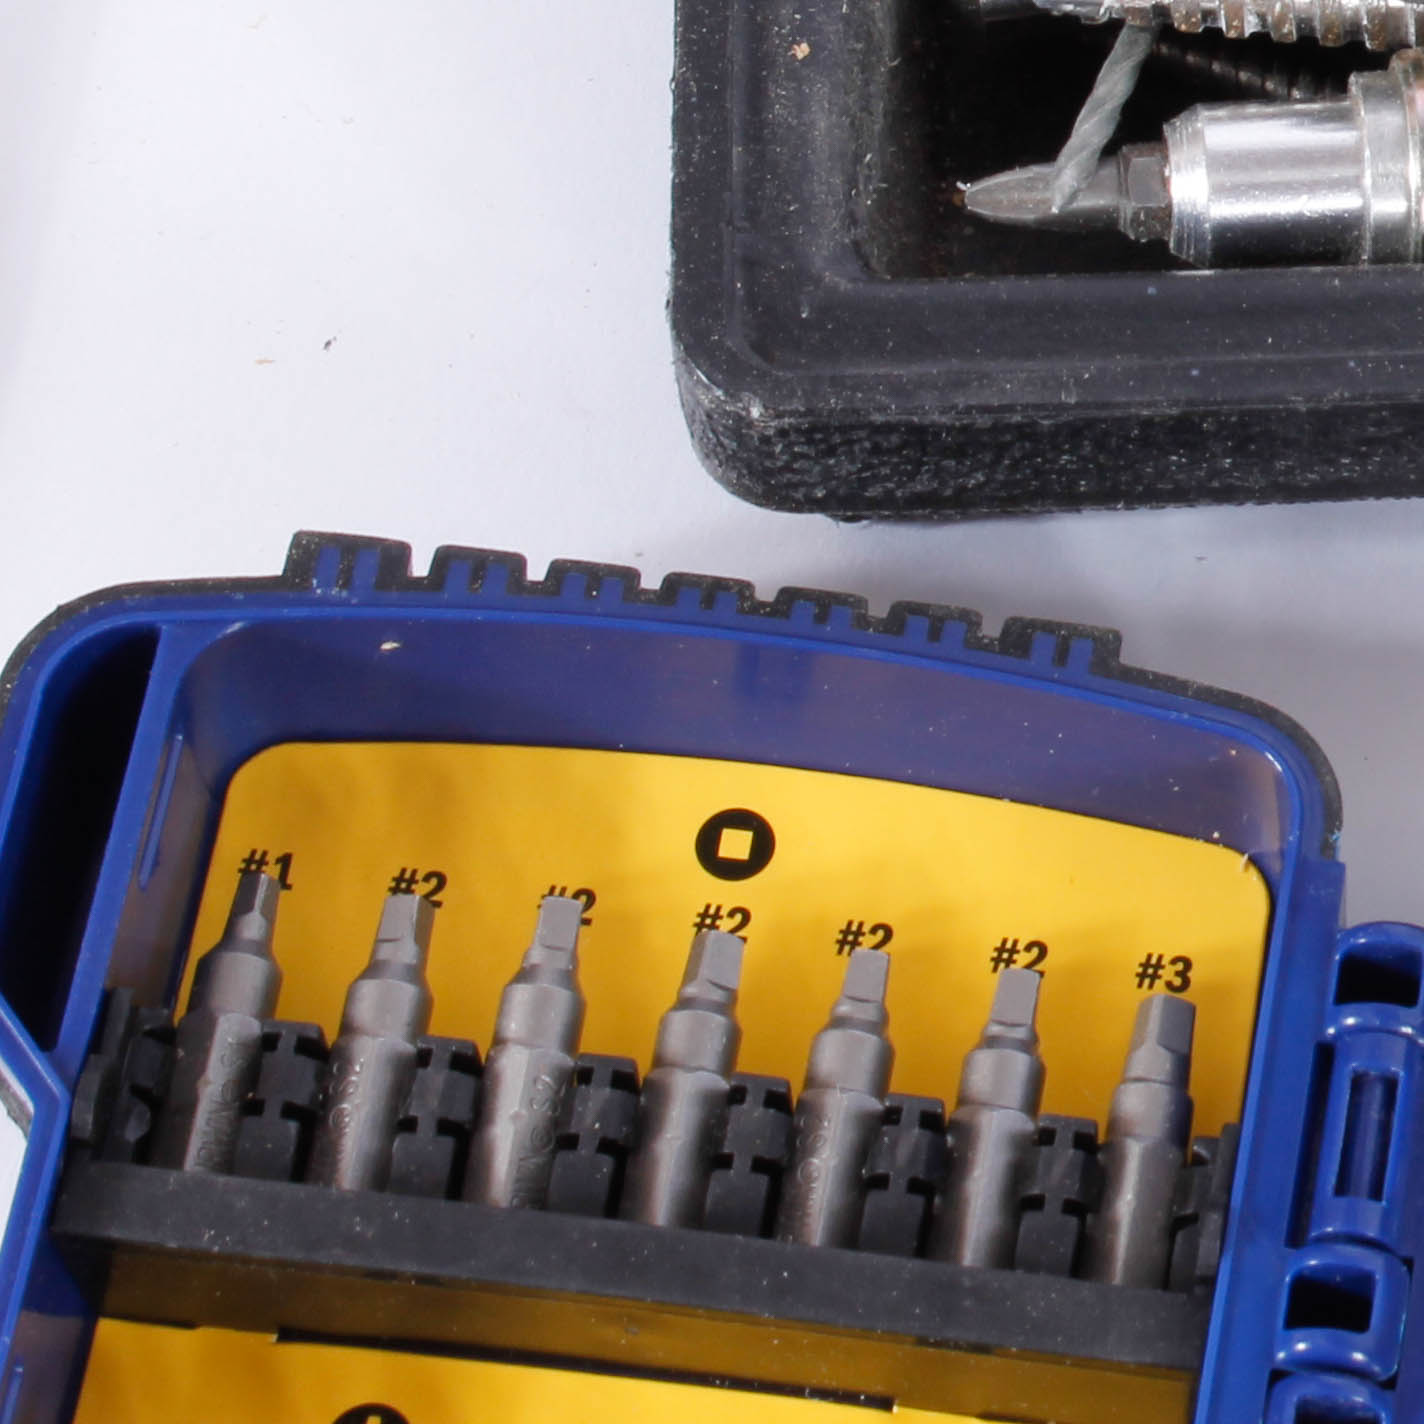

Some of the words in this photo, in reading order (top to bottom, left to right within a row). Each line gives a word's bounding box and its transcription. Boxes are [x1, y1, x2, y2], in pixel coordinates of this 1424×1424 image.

[238, 849, 293, 891] #1
[388, 867, 447, 908] #2
[693, 903, 751, 943] #2
[990, 937, 1048, 978] #2
[1135, 952, 1193, 993] #3
